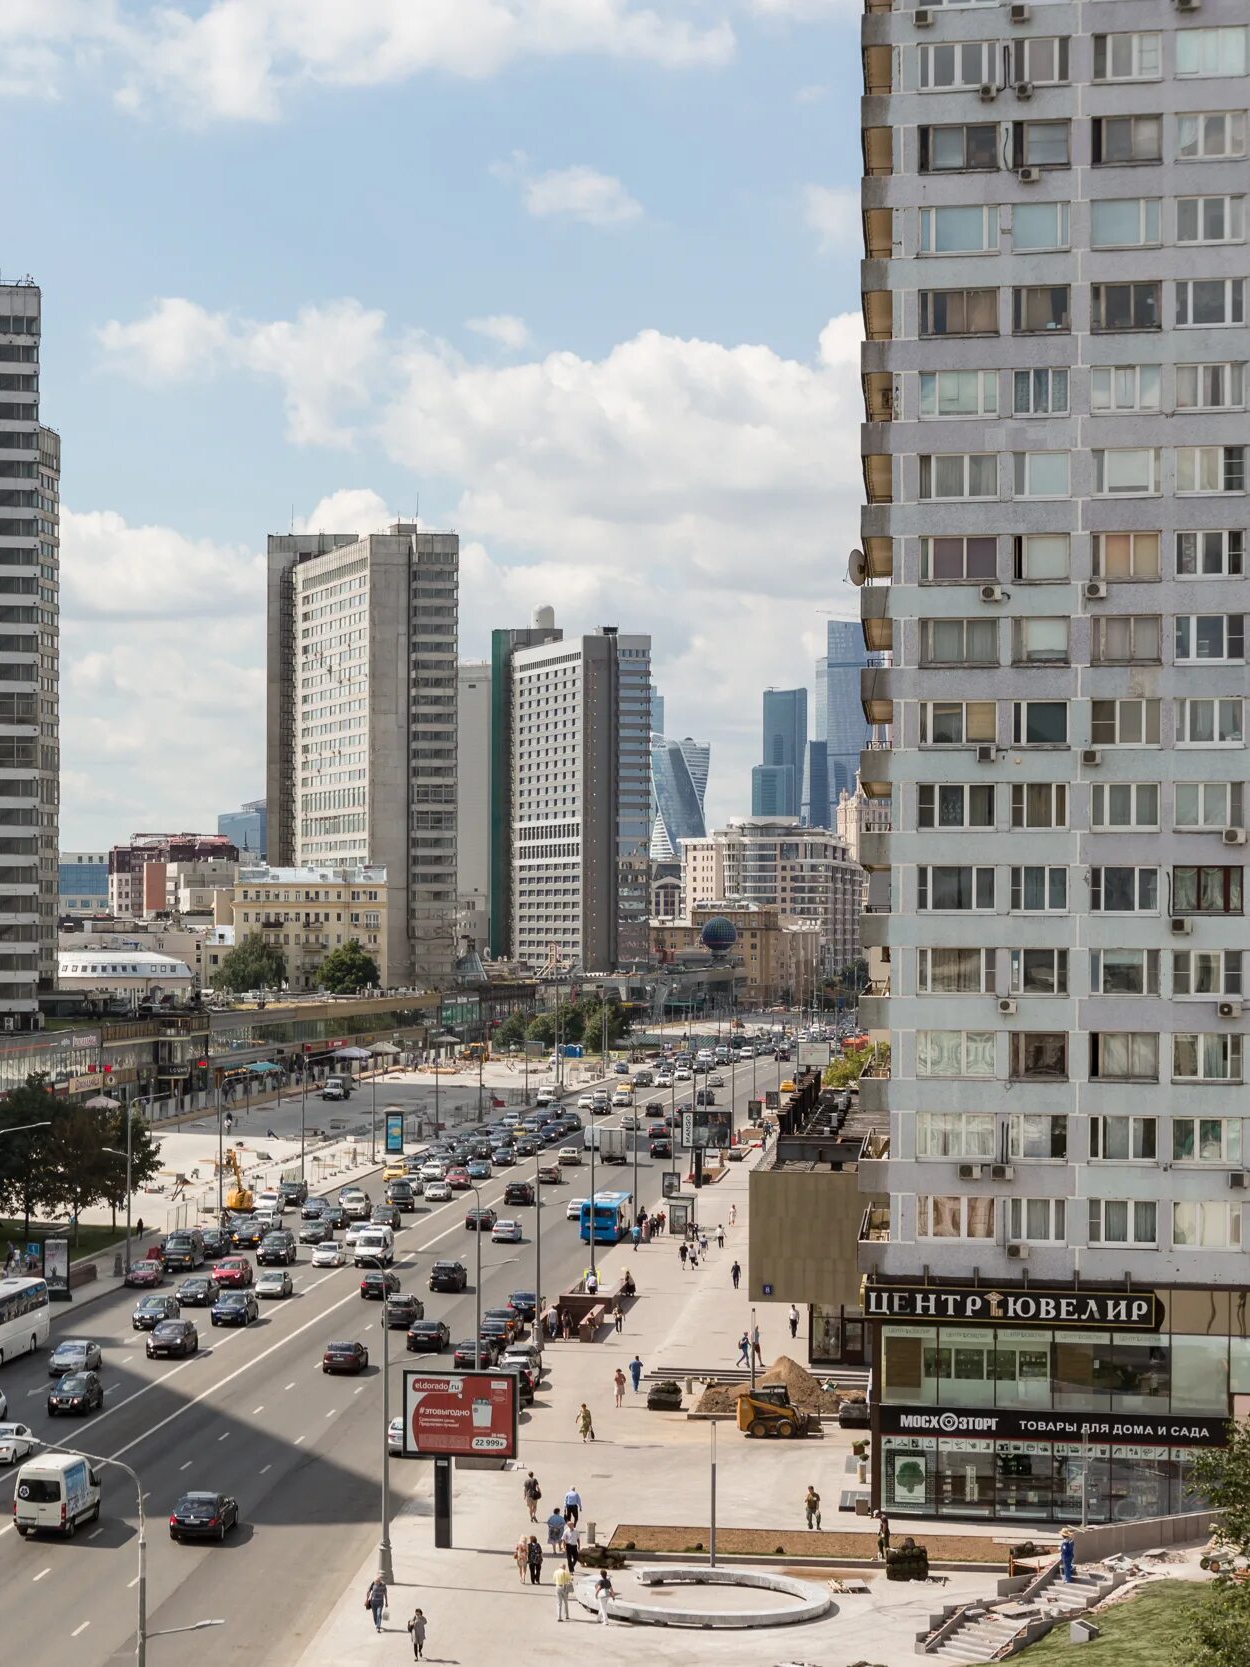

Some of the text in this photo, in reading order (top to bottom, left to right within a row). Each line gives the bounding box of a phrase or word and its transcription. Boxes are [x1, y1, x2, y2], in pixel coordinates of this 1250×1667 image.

[765, 1286, 770, 1294] 8
[868, 1292, 1149, 1321] ЦЕНТР ЮВЕЛИР
[900, 1412, 1210, 1438] МОСХОЗТОРГ ТОВАРЫ ДЛЯ ДОМА И САДА
